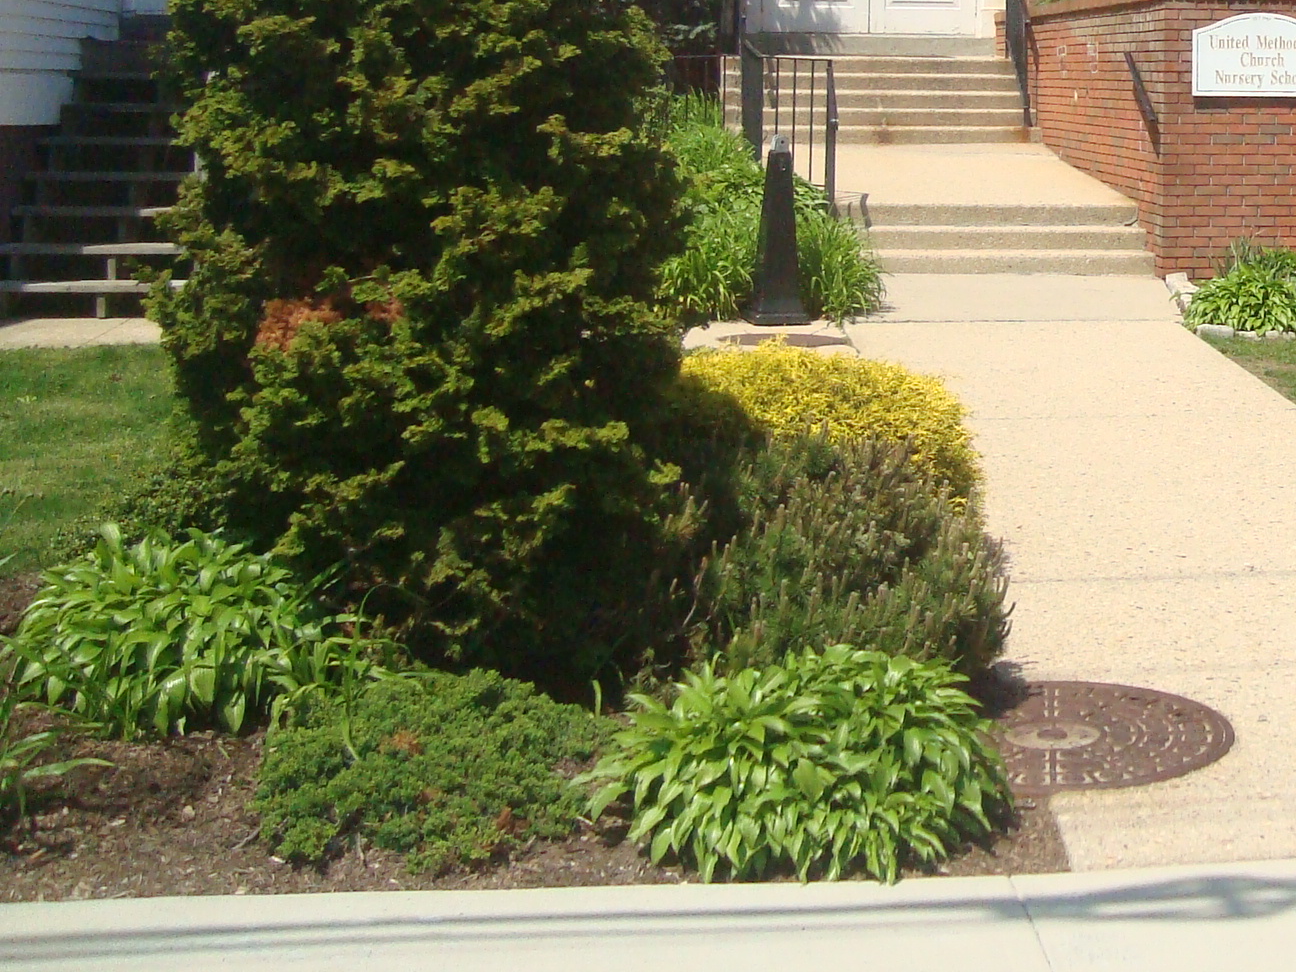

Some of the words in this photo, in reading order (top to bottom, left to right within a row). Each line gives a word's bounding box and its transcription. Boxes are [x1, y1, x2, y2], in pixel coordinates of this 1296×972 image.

[1209, 35, 1249, 50] United
[1240, 52, 1285, 67] Church
[1215, 70, 1264, 88] Nursery
